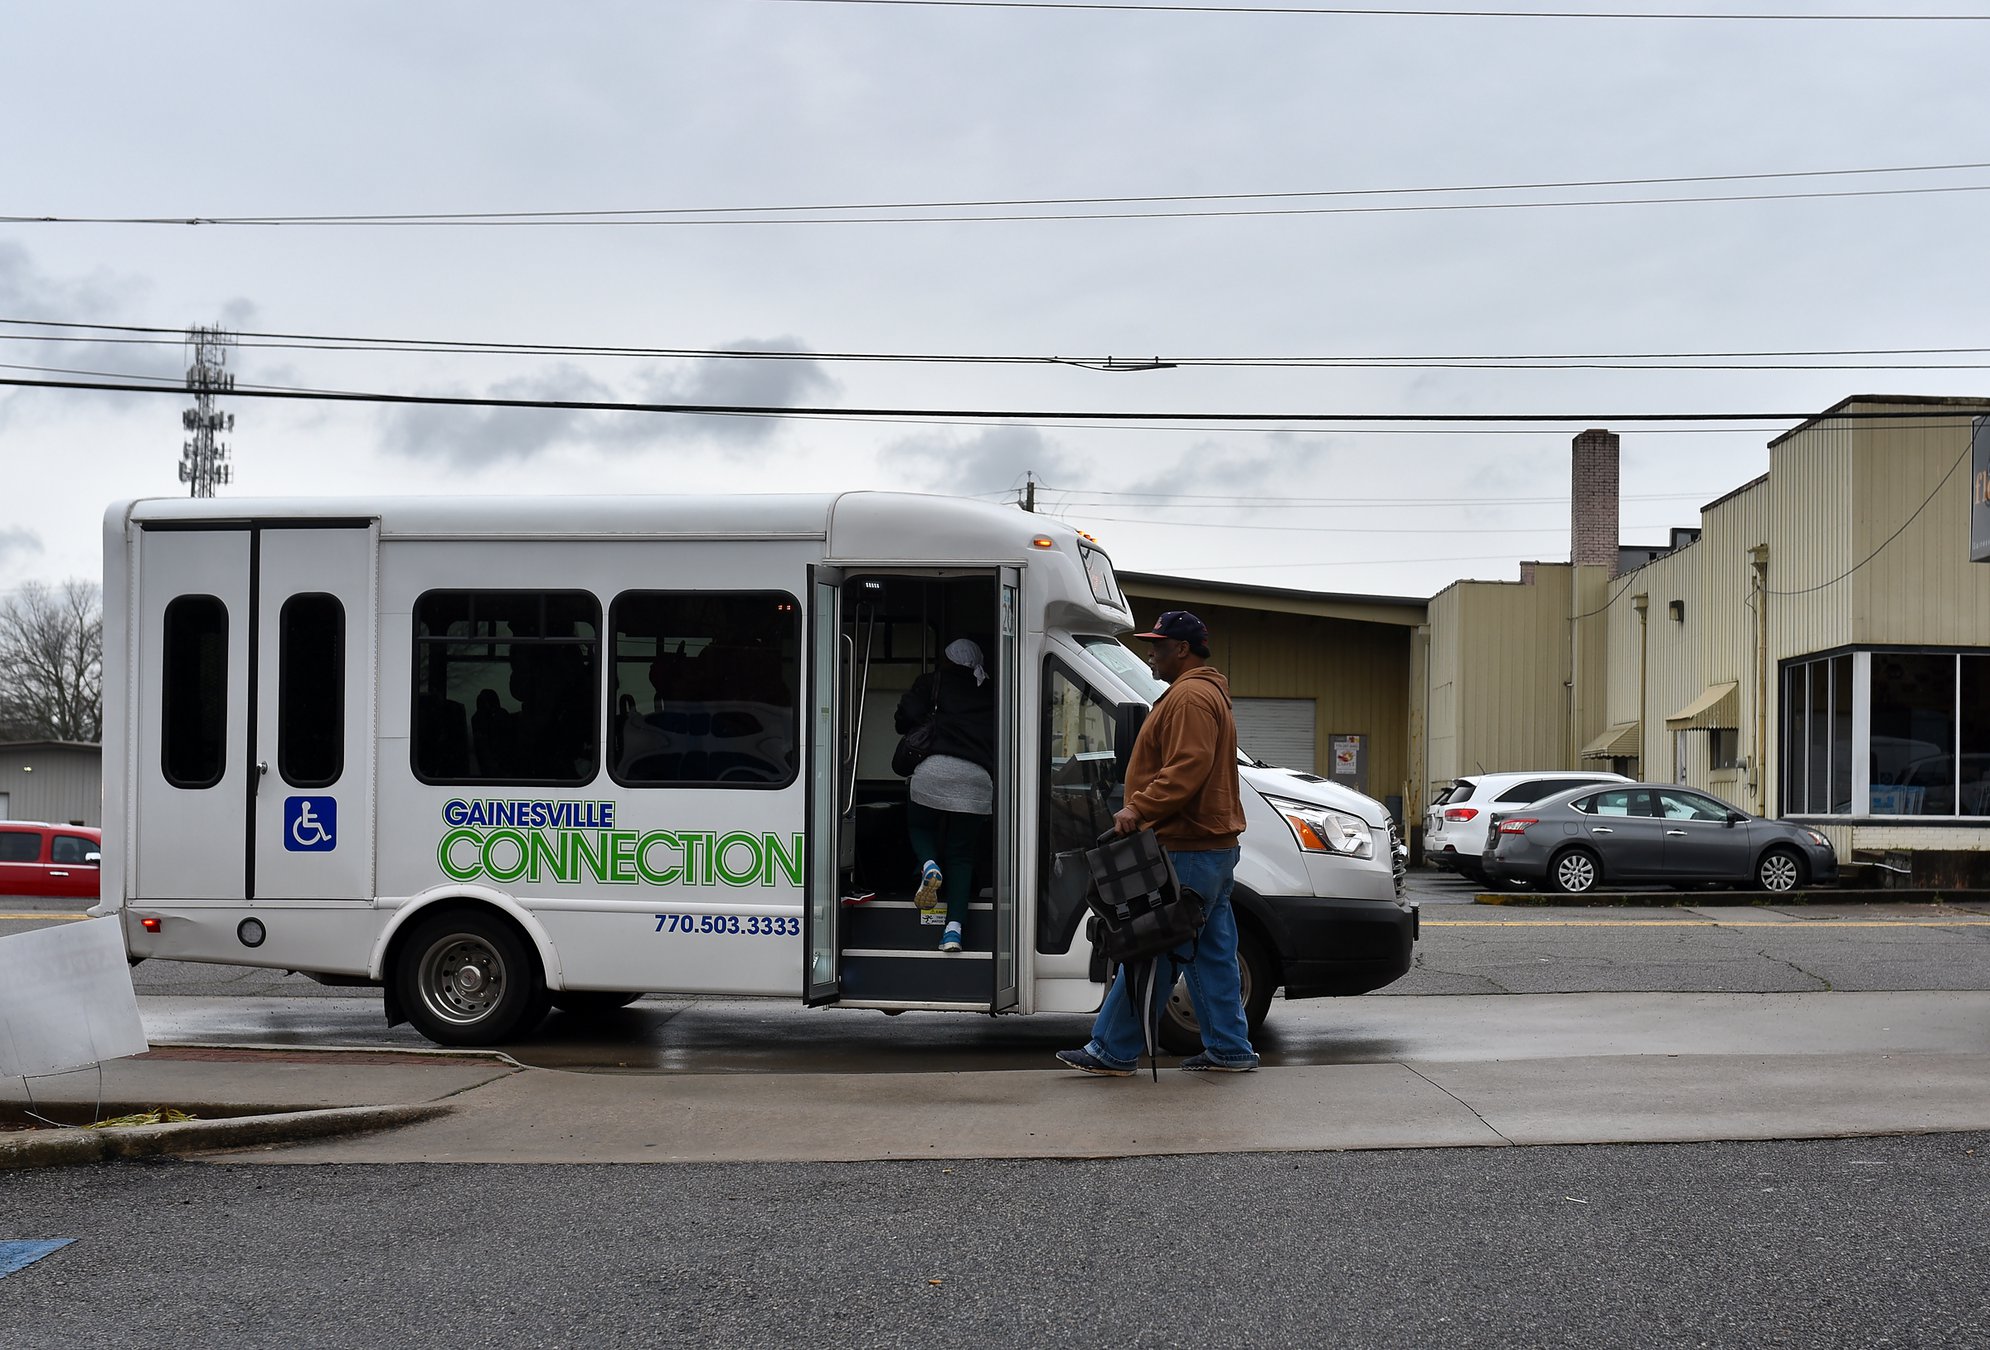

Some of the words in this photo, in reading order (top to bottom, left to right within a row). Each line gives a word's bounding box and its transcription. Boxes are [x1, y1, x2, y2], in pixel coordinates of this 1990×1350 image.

[443, 799, 614, 829] GAINESVILLE
[438, 828, 804, 887] CONNECTION
[654, 914, 800, 936] 770.503.3333
